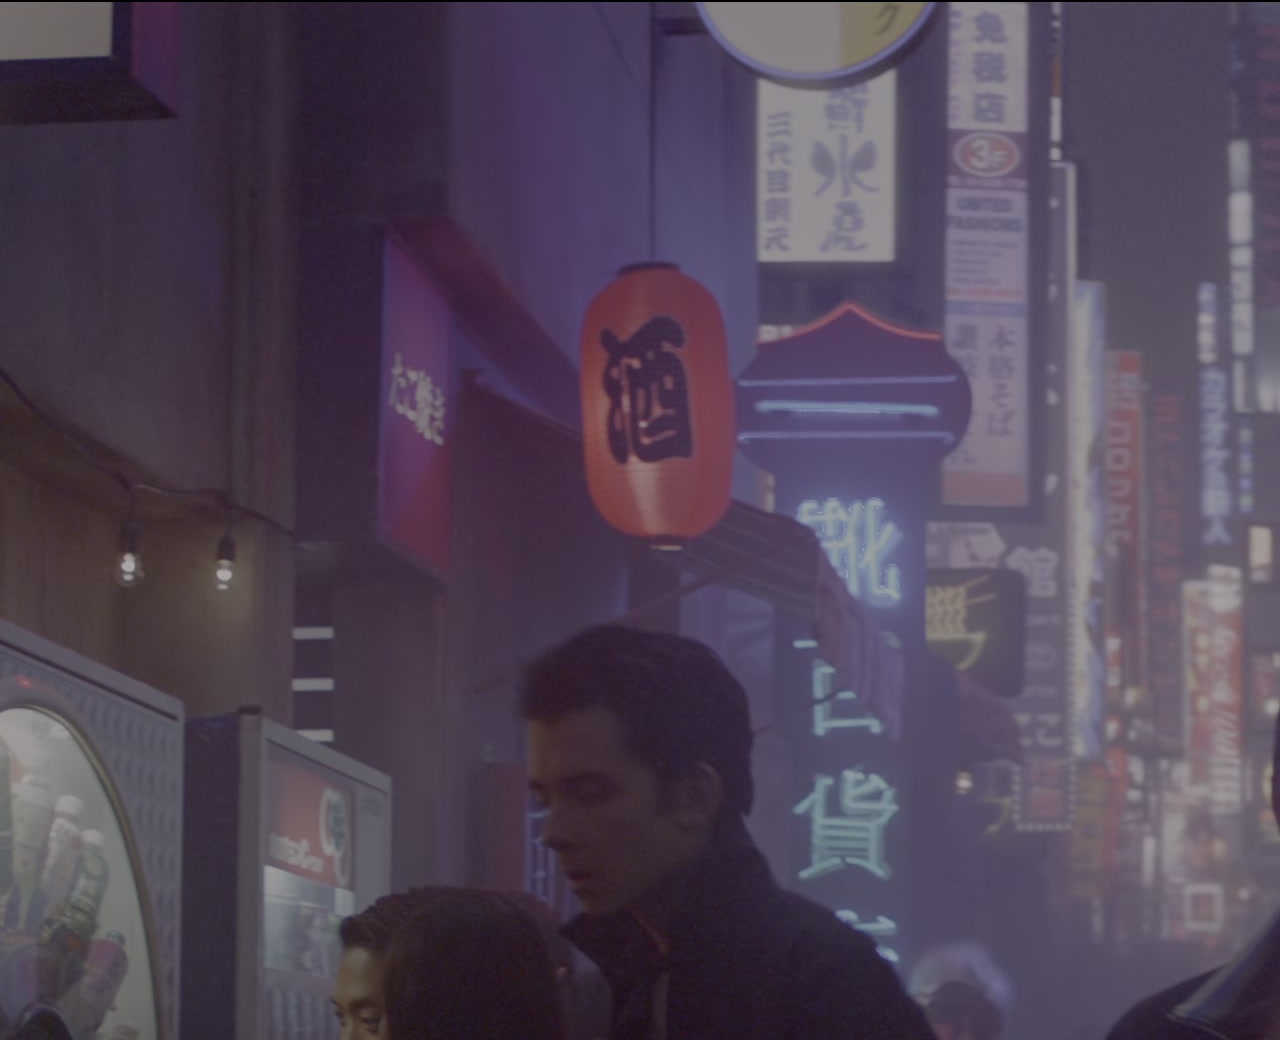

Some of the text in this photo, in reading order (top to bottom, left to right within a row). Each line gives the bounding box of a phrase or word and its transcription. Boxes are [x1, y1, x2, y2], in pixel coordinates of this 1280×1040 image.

[972, 11, 1008, 123] 免税店
[600, 315, 694, 464] 酒
[793, 496, 904, 963] 靴貨
